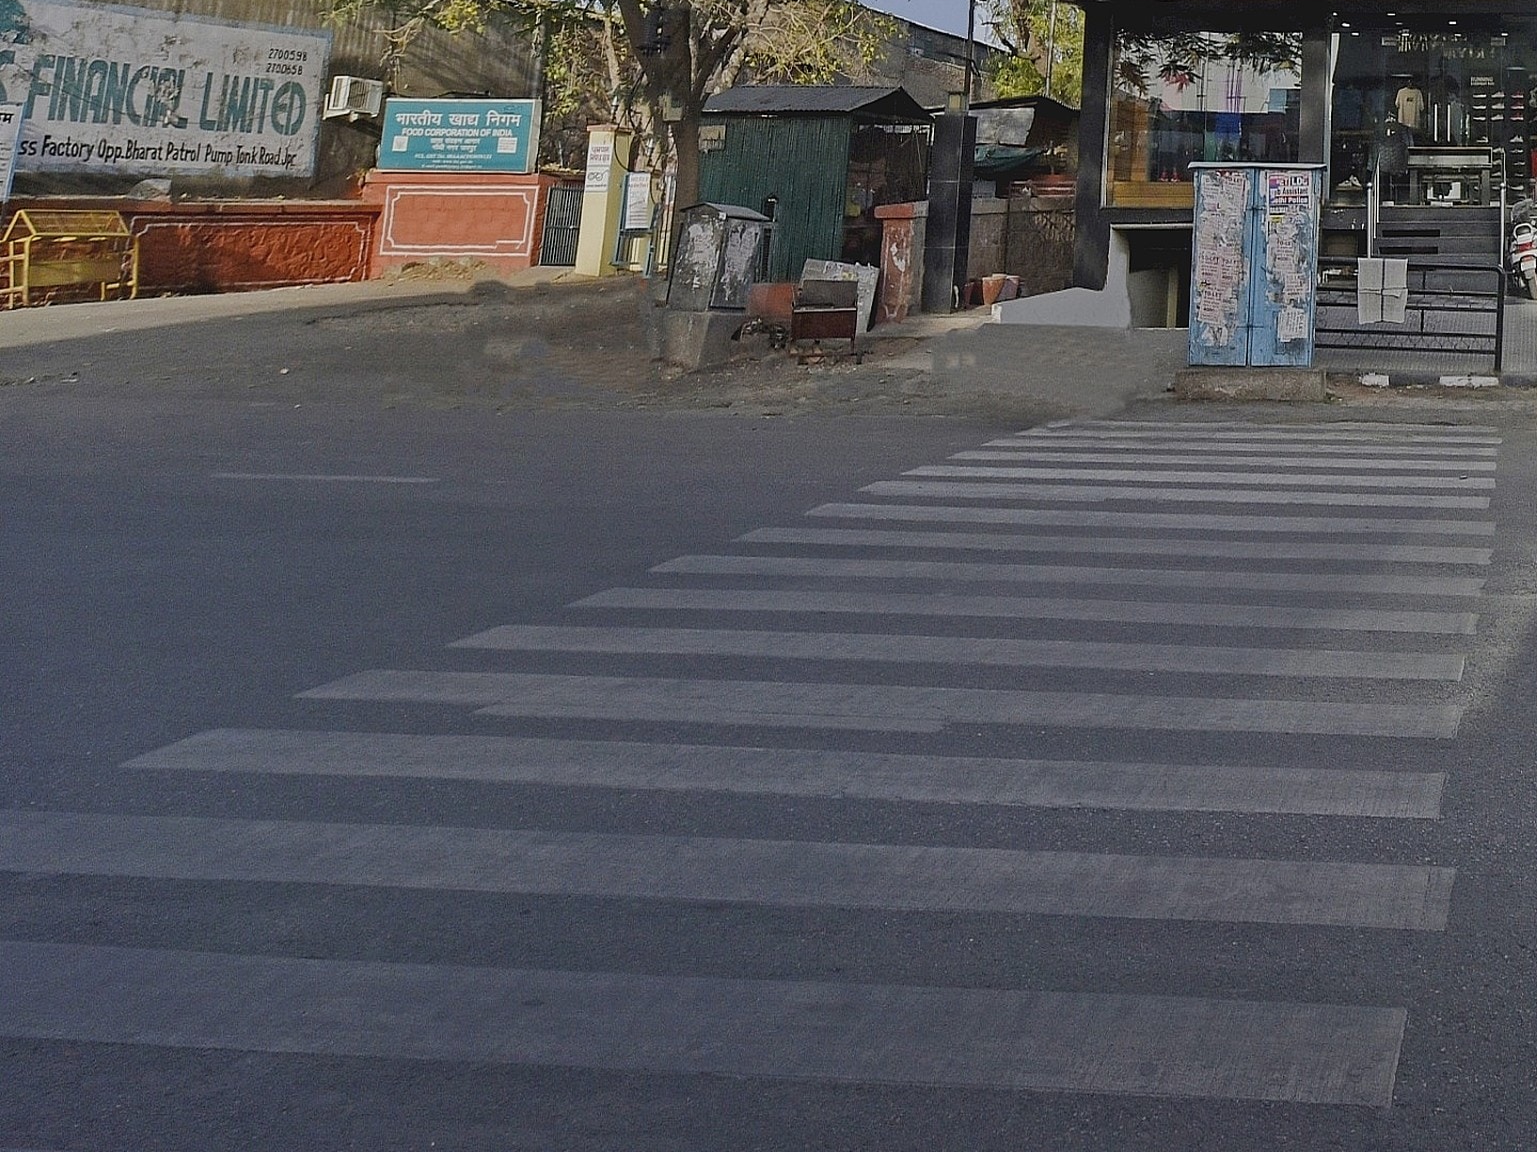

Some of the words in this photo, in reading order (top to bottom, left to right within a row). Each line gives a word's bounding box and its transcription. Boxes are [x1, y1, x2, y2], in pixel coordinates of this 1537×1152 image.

[401, 127, 424, 137] FOOD
[424, 127, 479, 137] CORPORATION
[479, 128, 492, 137] OF
[492, 128, 513, 138] INDIA
[40, 134, 95, 162] Factory
[165, 141, 202, 163] Patrol
[204, 143, 233, 167] Pump
